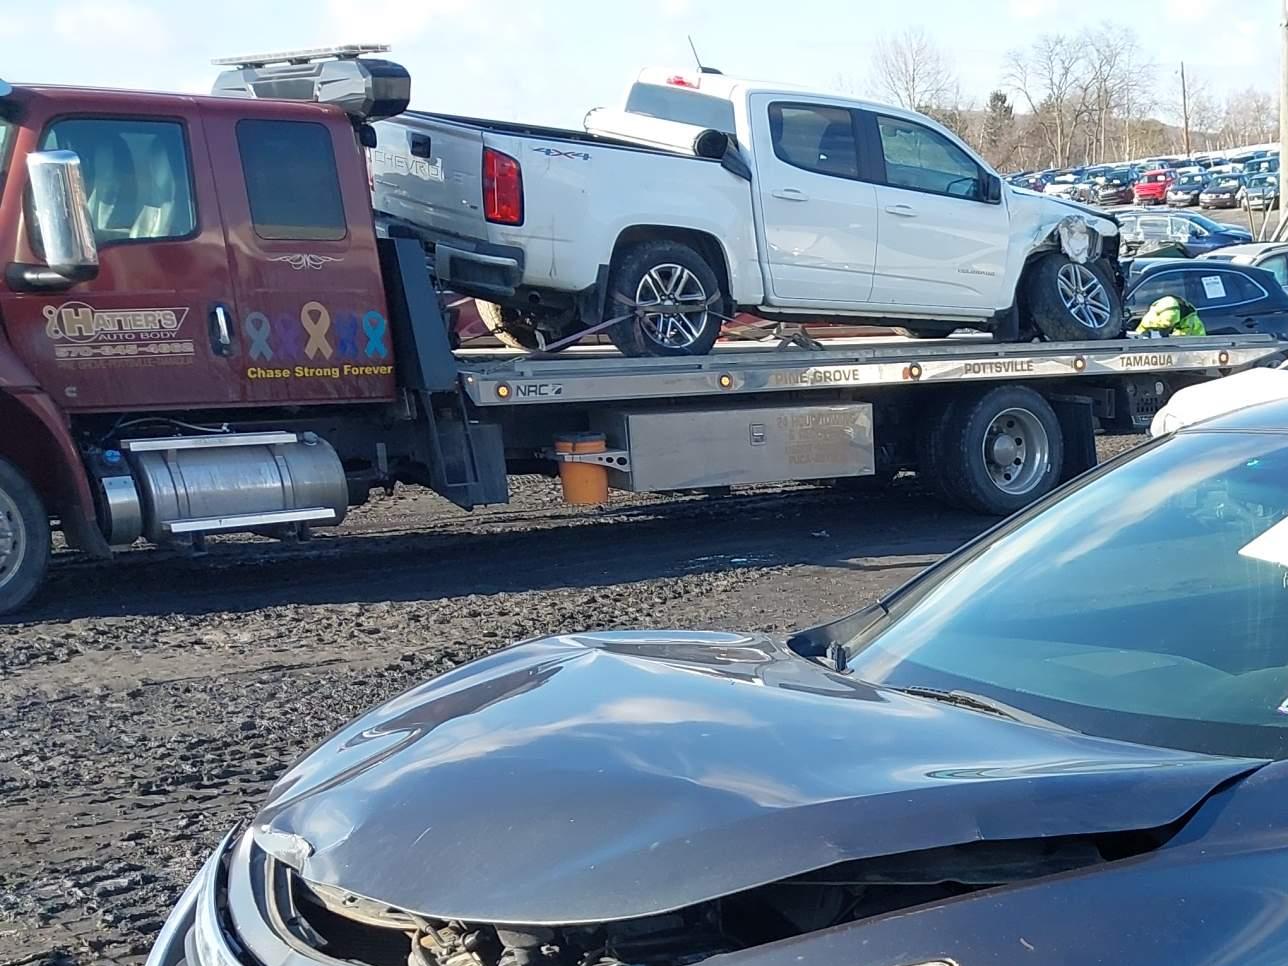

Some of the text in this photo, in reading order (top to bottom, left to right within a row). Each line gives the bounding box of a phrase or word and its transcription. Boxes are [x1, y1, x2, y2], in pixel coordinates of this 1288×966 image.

[61, 307, 178, 336] HATTER'S
[97, 331, 177, 341] AUTO BODY
[964, 360, 1034, 375] POTTSVILLE
[1120, 354, 1174, 368] TAMAQUA
[247, 364, 393, 379] Chase Strong Forever
[775, 369, 860, 385] PINE GROVE
[515, 384, 549, 397] NRC
